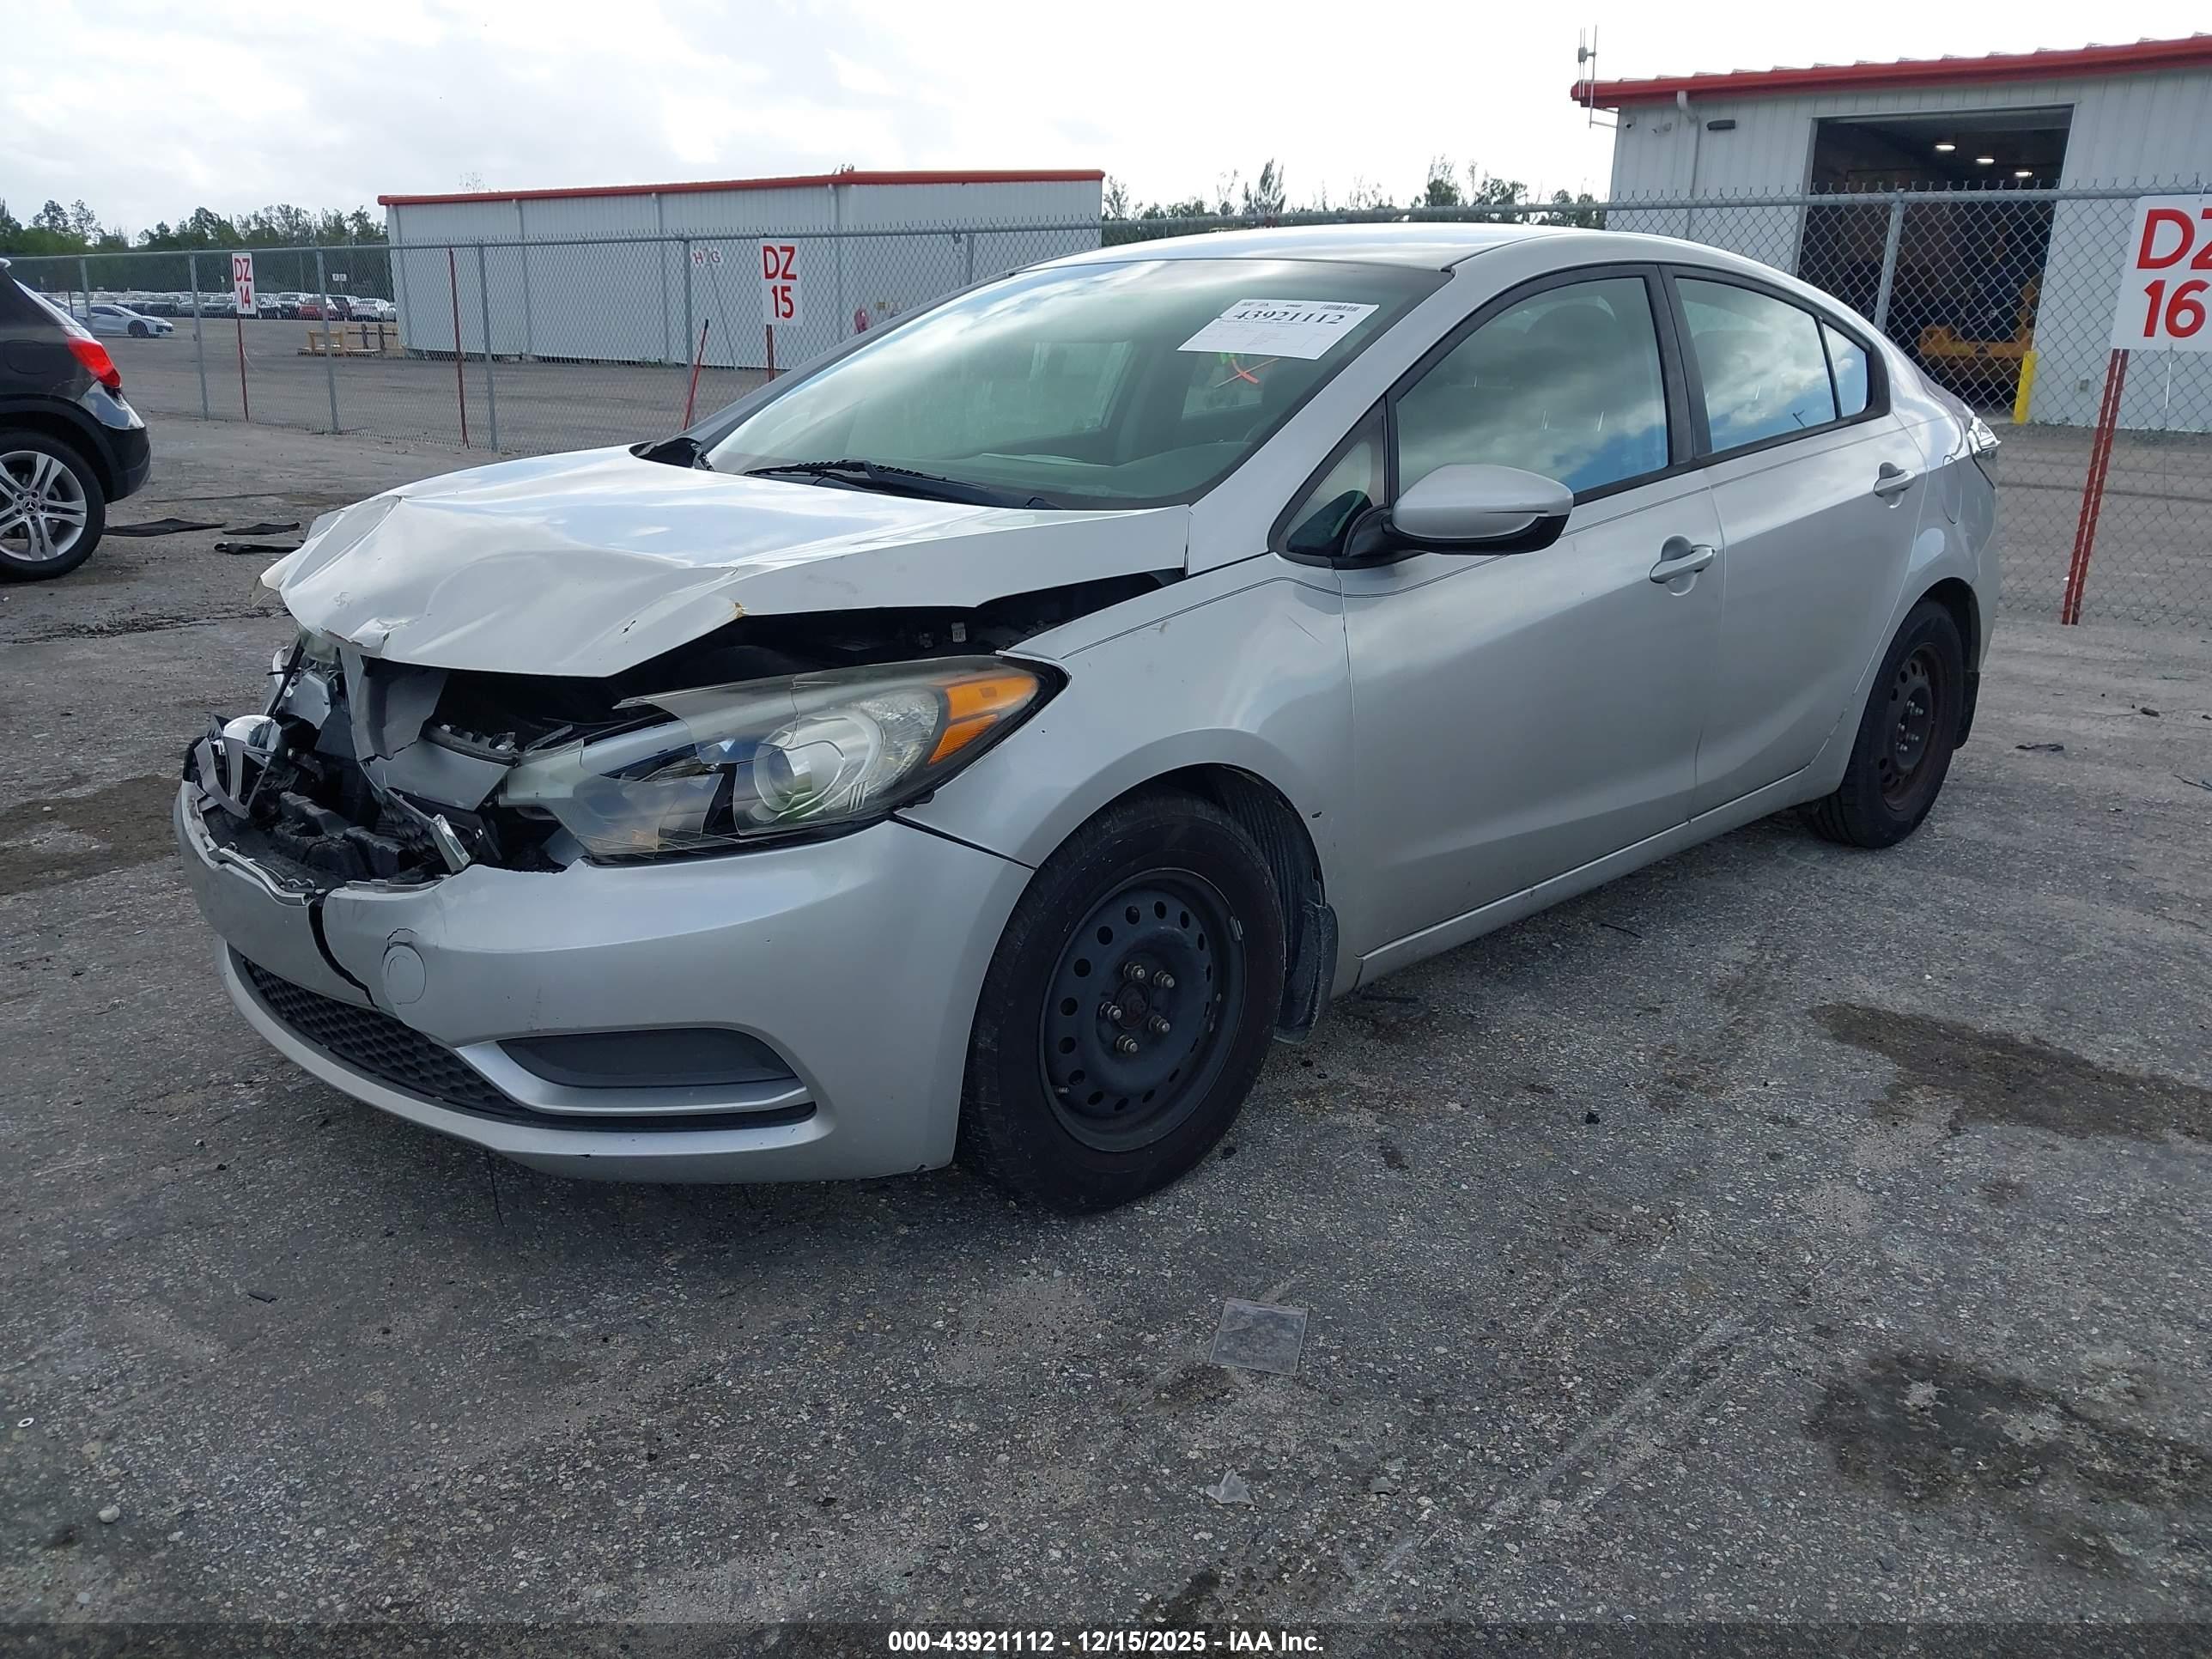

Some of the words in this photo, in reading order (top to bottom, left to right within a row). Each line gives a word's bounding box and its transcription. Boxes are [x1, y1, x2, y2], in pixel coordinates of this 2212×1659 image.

[234, 258, 252, 282] DZ
[763, 246, 798, 281] DZ
[240, 286, 251, 309] 14
[771, 285, 794, 319] 15
[2143, 279, 2210, 337] 16
[1233, 309, 1346, 325] 43921112
